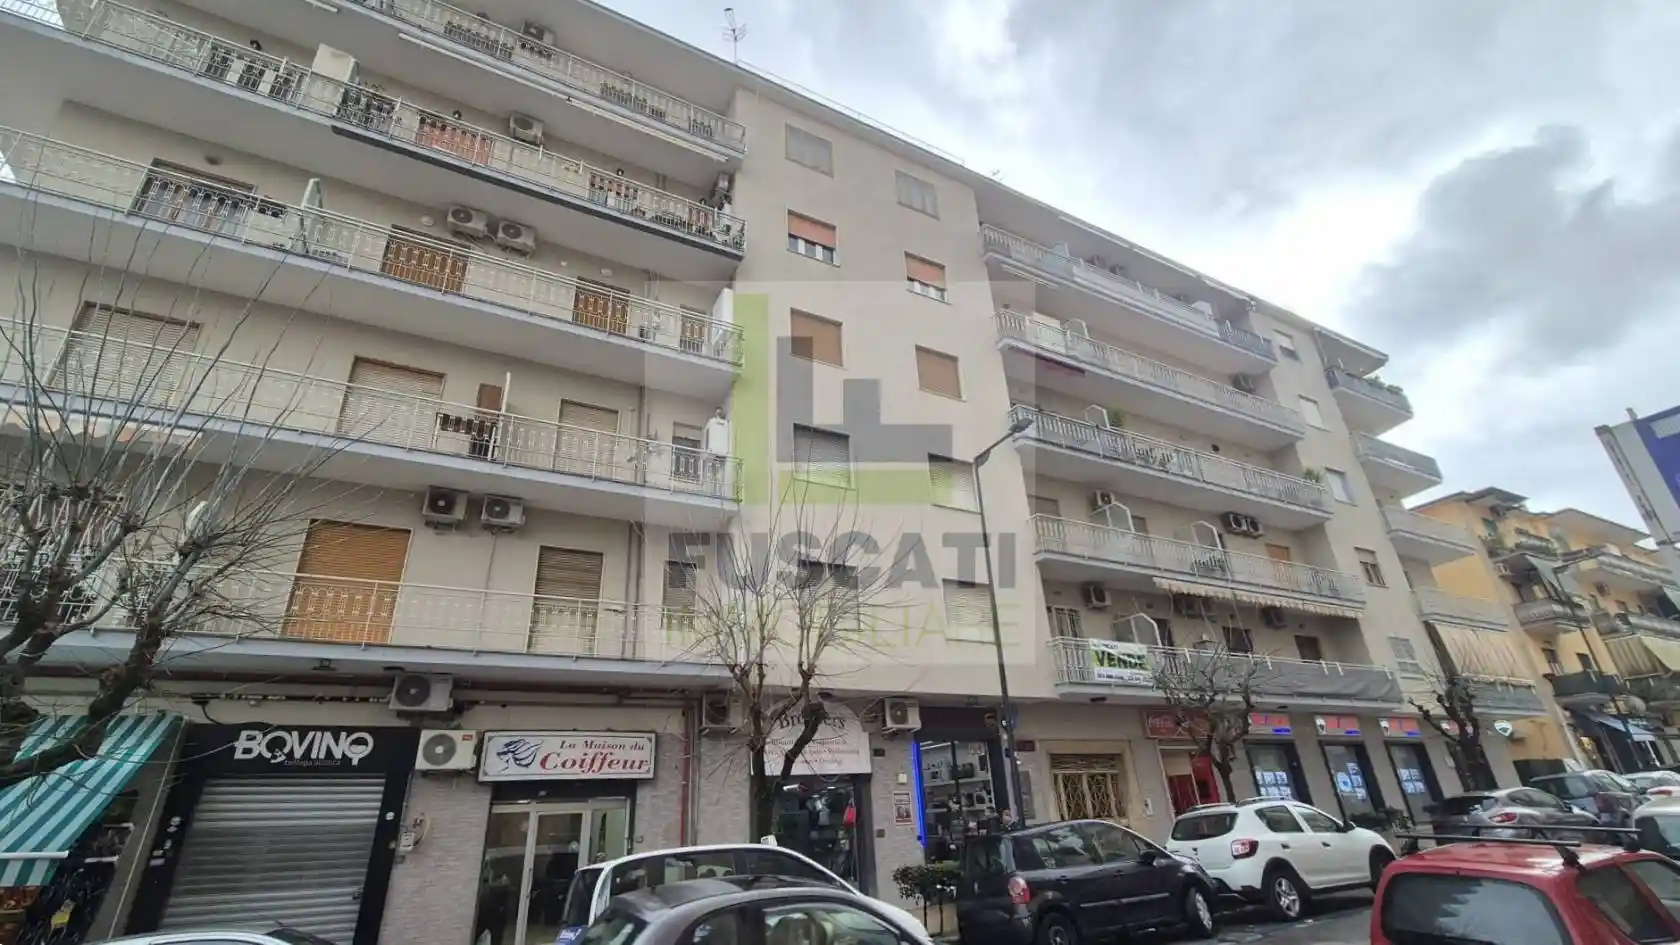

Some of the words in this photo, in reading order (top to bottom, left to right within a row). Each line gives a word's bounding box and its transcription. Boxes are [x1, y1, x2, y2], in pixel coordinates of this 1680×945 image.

[1093, 650, 1150, 671] VENDE
[233, 729, 375, 767] BOVINO
[559, 739, 577, 750] La
[583, 740, 627, 751] Maison
[629, 741, 646, 751] du
[539, 751, 649, 774] Coiffeur
